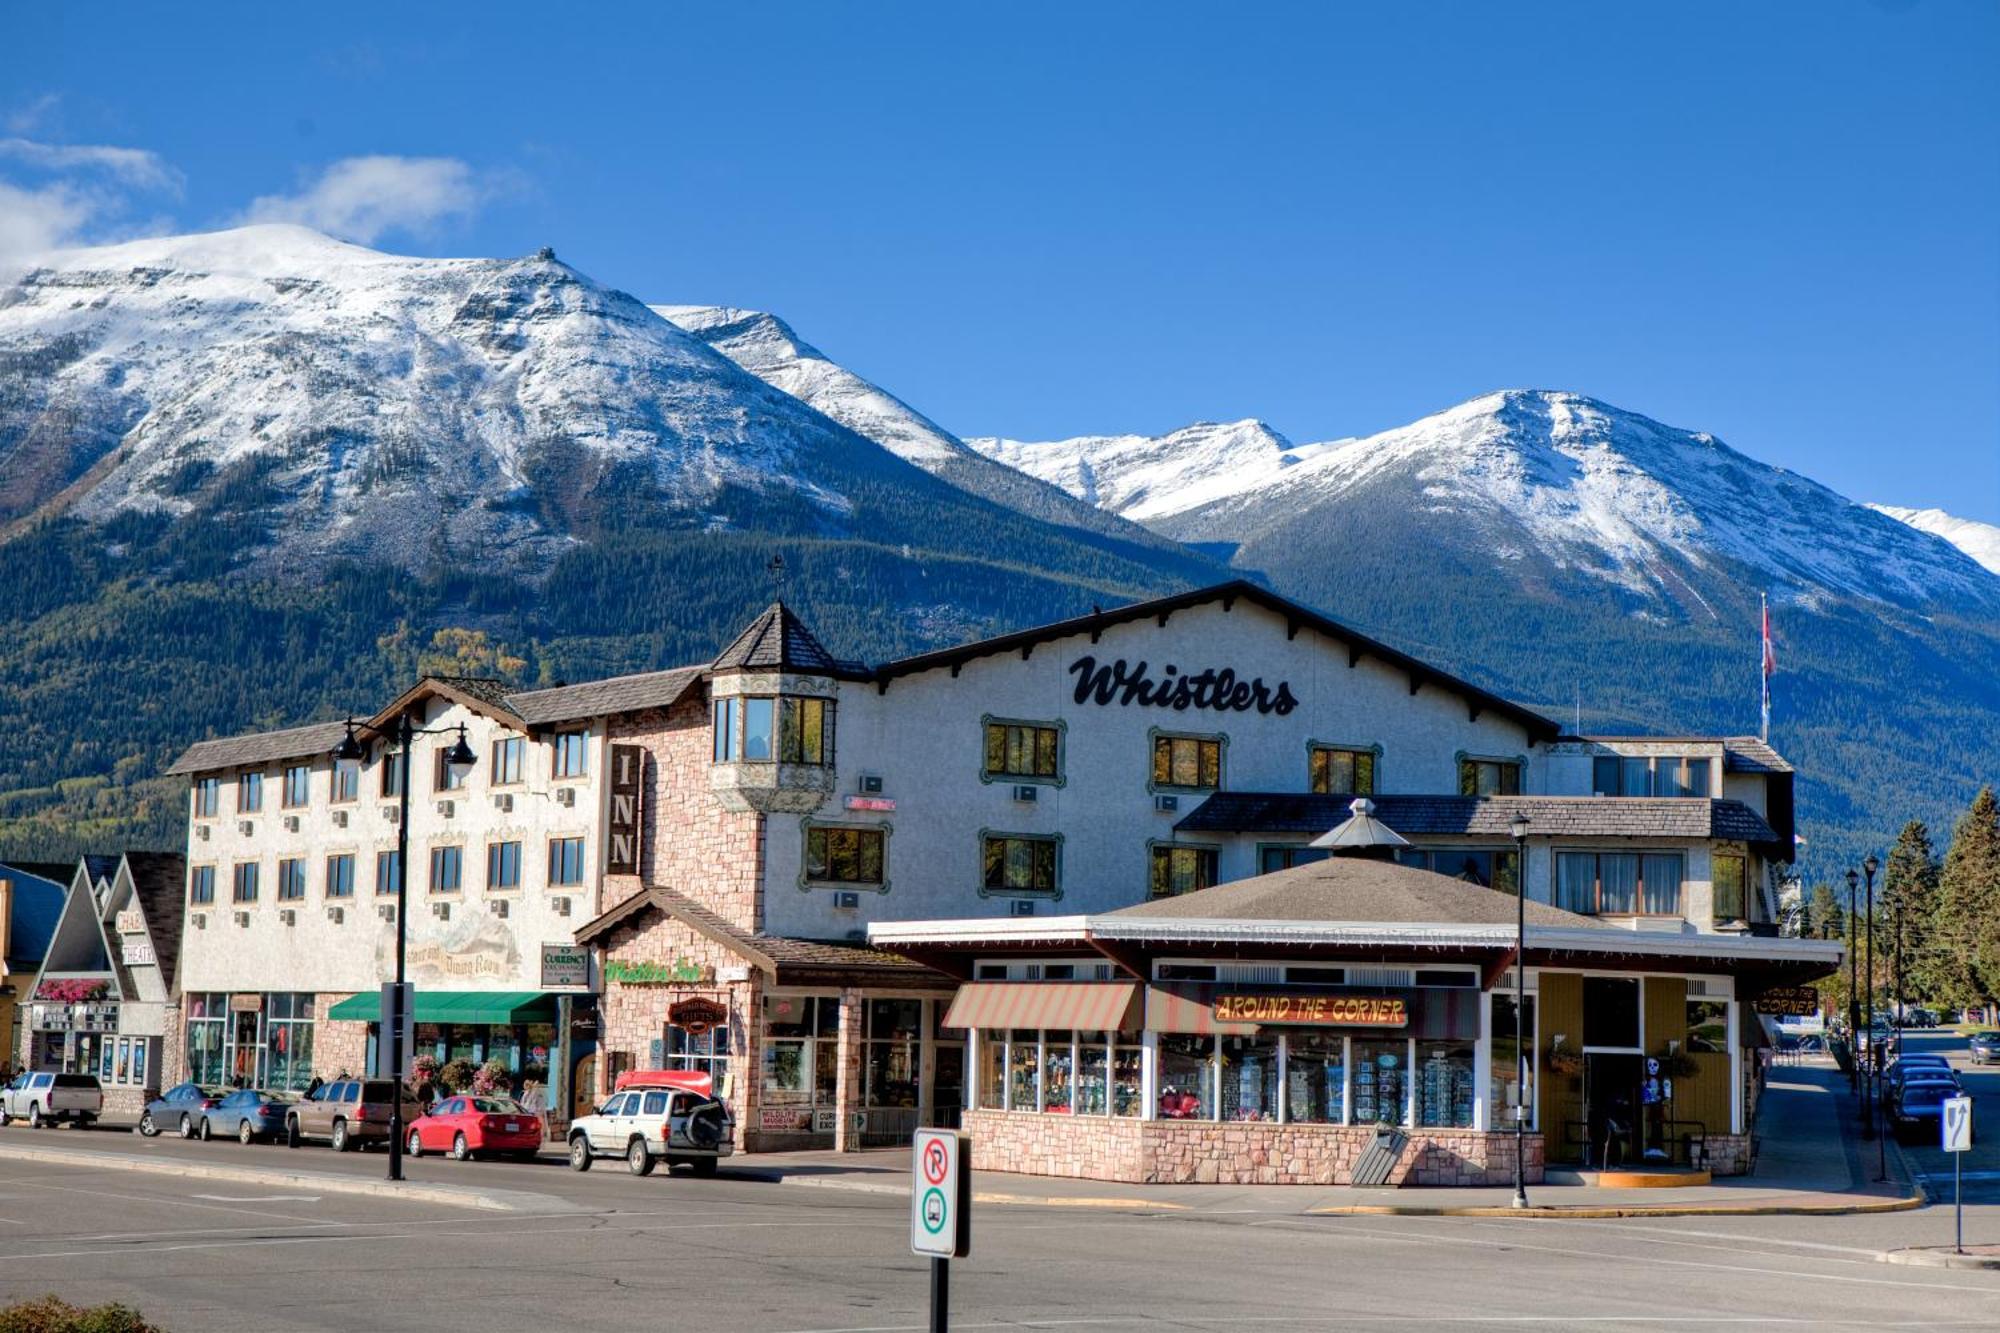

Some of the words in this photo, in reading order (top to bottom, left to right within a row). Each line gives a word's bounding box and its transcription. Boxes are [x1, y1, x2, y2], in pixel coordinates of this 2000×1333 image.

[1069, 656, 1299, 715] Whistlers
[611, 754, 636, 864] INN
[119, 912, 142, 930] CHAB
[123, 946, 155, 963] THEATR
[446, 956, 473, 975] Dining
[1763, 987, 1797, 997] ROUND
[1800, 988, 1815, 998] THE
[1216, 996, 1290, 1019] AROUND
[1296, 997, 1328, 1020] THE
[1332, 999, 1403, 1022] CORNER
[1759, 999, 1816, 1014] CORNER
[681, 1011, 713, 1021] GIFTS
